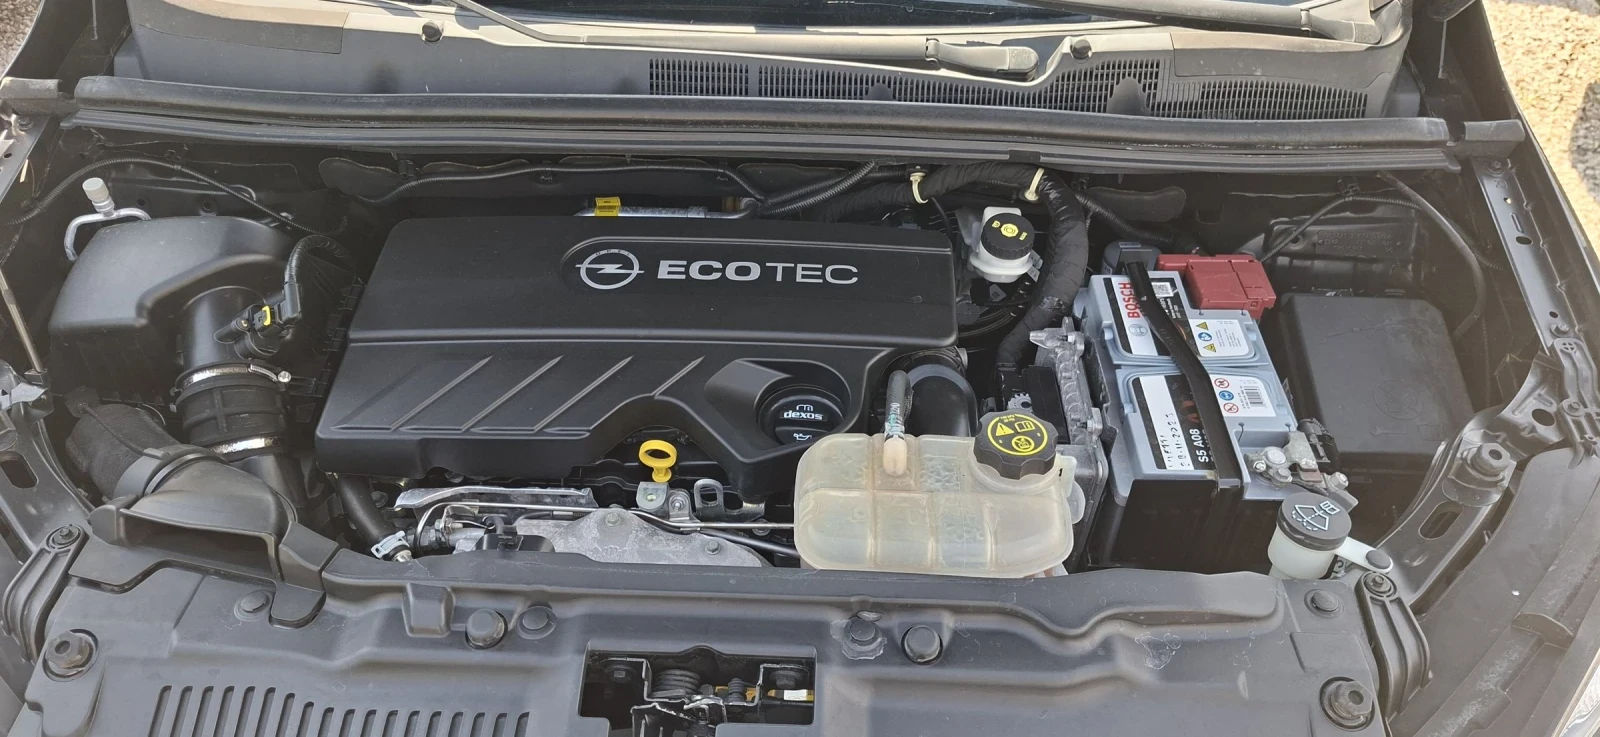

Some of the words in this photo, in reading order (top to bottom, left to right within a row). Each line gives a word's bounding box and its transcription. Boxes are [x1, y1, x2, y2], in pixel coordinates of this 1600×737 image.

[657, 260, 858, 285] ECOTEC
[1118, 282, 1141, 319] BOSCH
[783, 410, 824, 420] dexos
[1189, 428, 1205, 448] A08
[1195, 450, 1209, 463] S5
